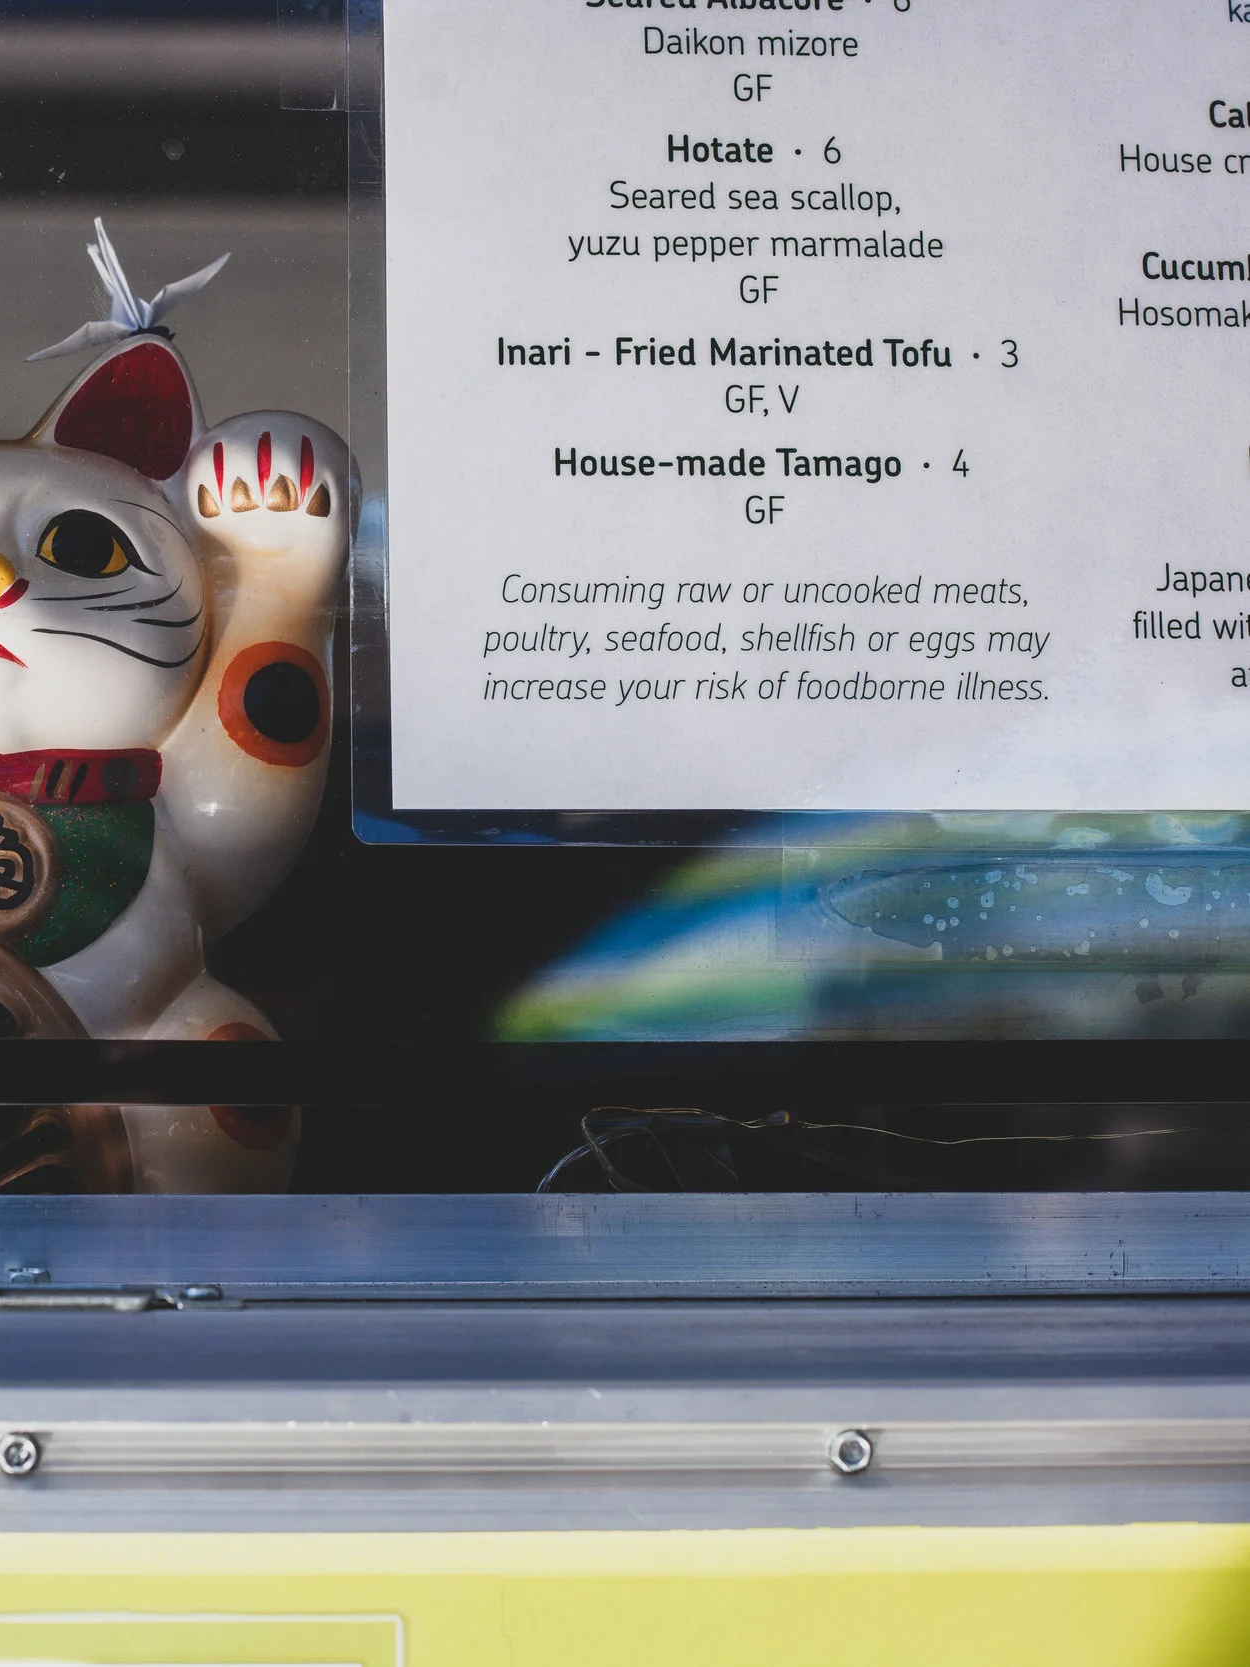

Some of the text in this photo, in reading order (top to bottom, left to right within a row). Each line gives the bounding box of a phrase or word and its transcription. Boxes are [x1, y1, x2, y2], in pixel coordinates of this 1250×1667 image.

[643, 26, 859, 57] Daikon mizore
[733, 73, 773, 102] GF
[667, 133, 774, 164] Hotate
[823, 135, 842, 165] 6
[1120, 144, 1212, 173] House
[609, 179, 901, 217] Seared sea scallop,
[567, 230, 944, 262] yuzu pepper marmalade
[1142, 251, 1250, 281] Cucum
[739, 275, 780, 304] GF
[498, 336, 570, 366] Inari
[615, 336, 697, 366] Fried
[709, 337, 874, 367] Marinated
[882, 338, 953, 368] Tofu
[1000, 339, 1019, 368] 3
[725, 384, 800, 417] GF, V
[554, 446, 766, 477] House-made
[775, 447, 902, 484] Tamago
[952, 448, 970, 478] 4
[745, 495, 786, 524] GF
[501, 574, 1028, 610] Consuming raw or uncooked meats,
[1156, 562, 1250, 598] Japan
[483, 622, 1051, 659] poultry, seafood, shellfish or eggs may
[1132, 609, 1202, 640] filled
[483, 671, 1050, 706] increase your risk of foodborne illness.
[1231, 667, 1250, 687] a
